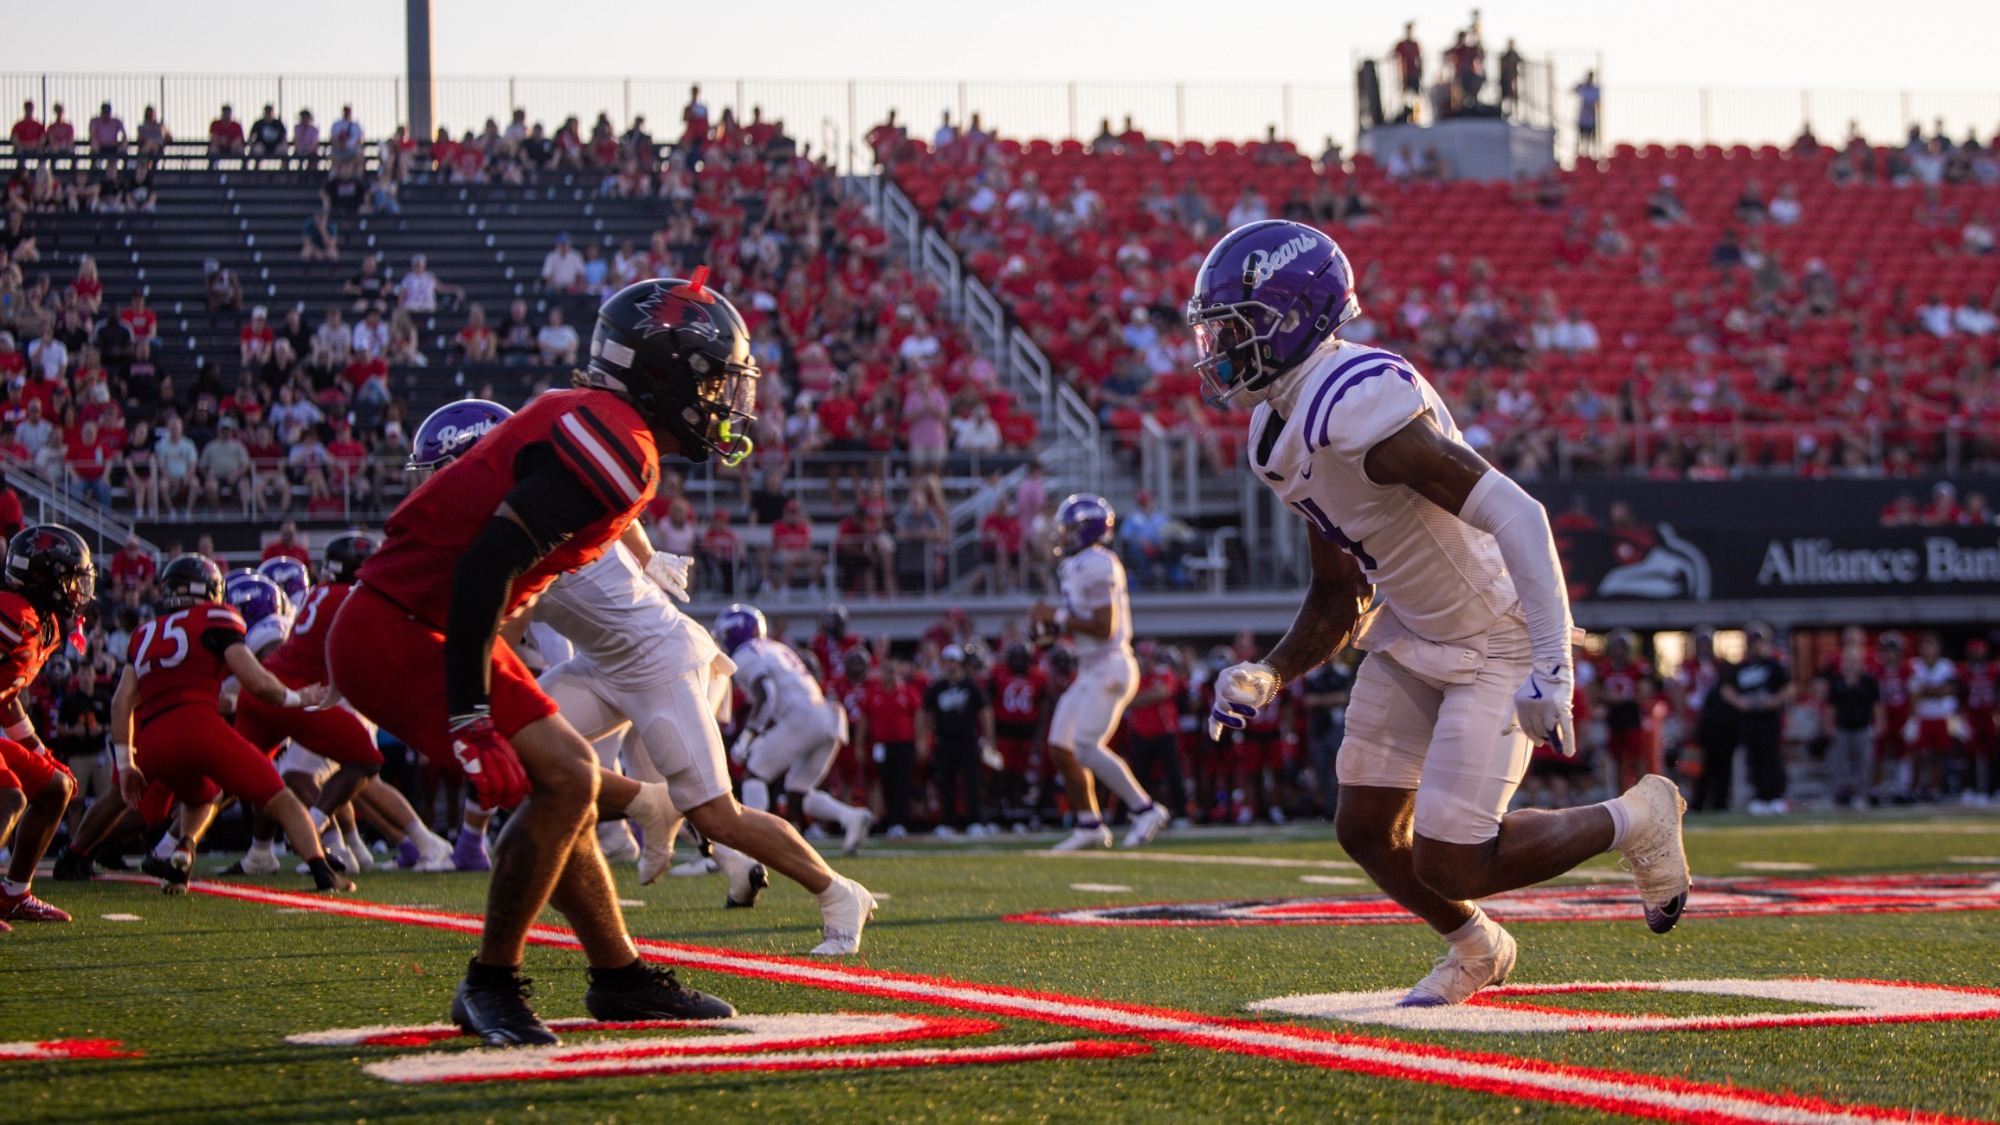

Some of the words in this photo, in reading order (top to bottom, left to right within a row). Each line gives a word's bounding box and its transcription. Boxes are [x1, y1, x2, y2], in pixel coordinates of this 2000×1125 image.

[1243, 233, 1317, 289] Bears
[1758, 538, 1919, 584] Alliance
[1926, 536, 2000, 582] Ban
[134, 610, 189, 680] 25
